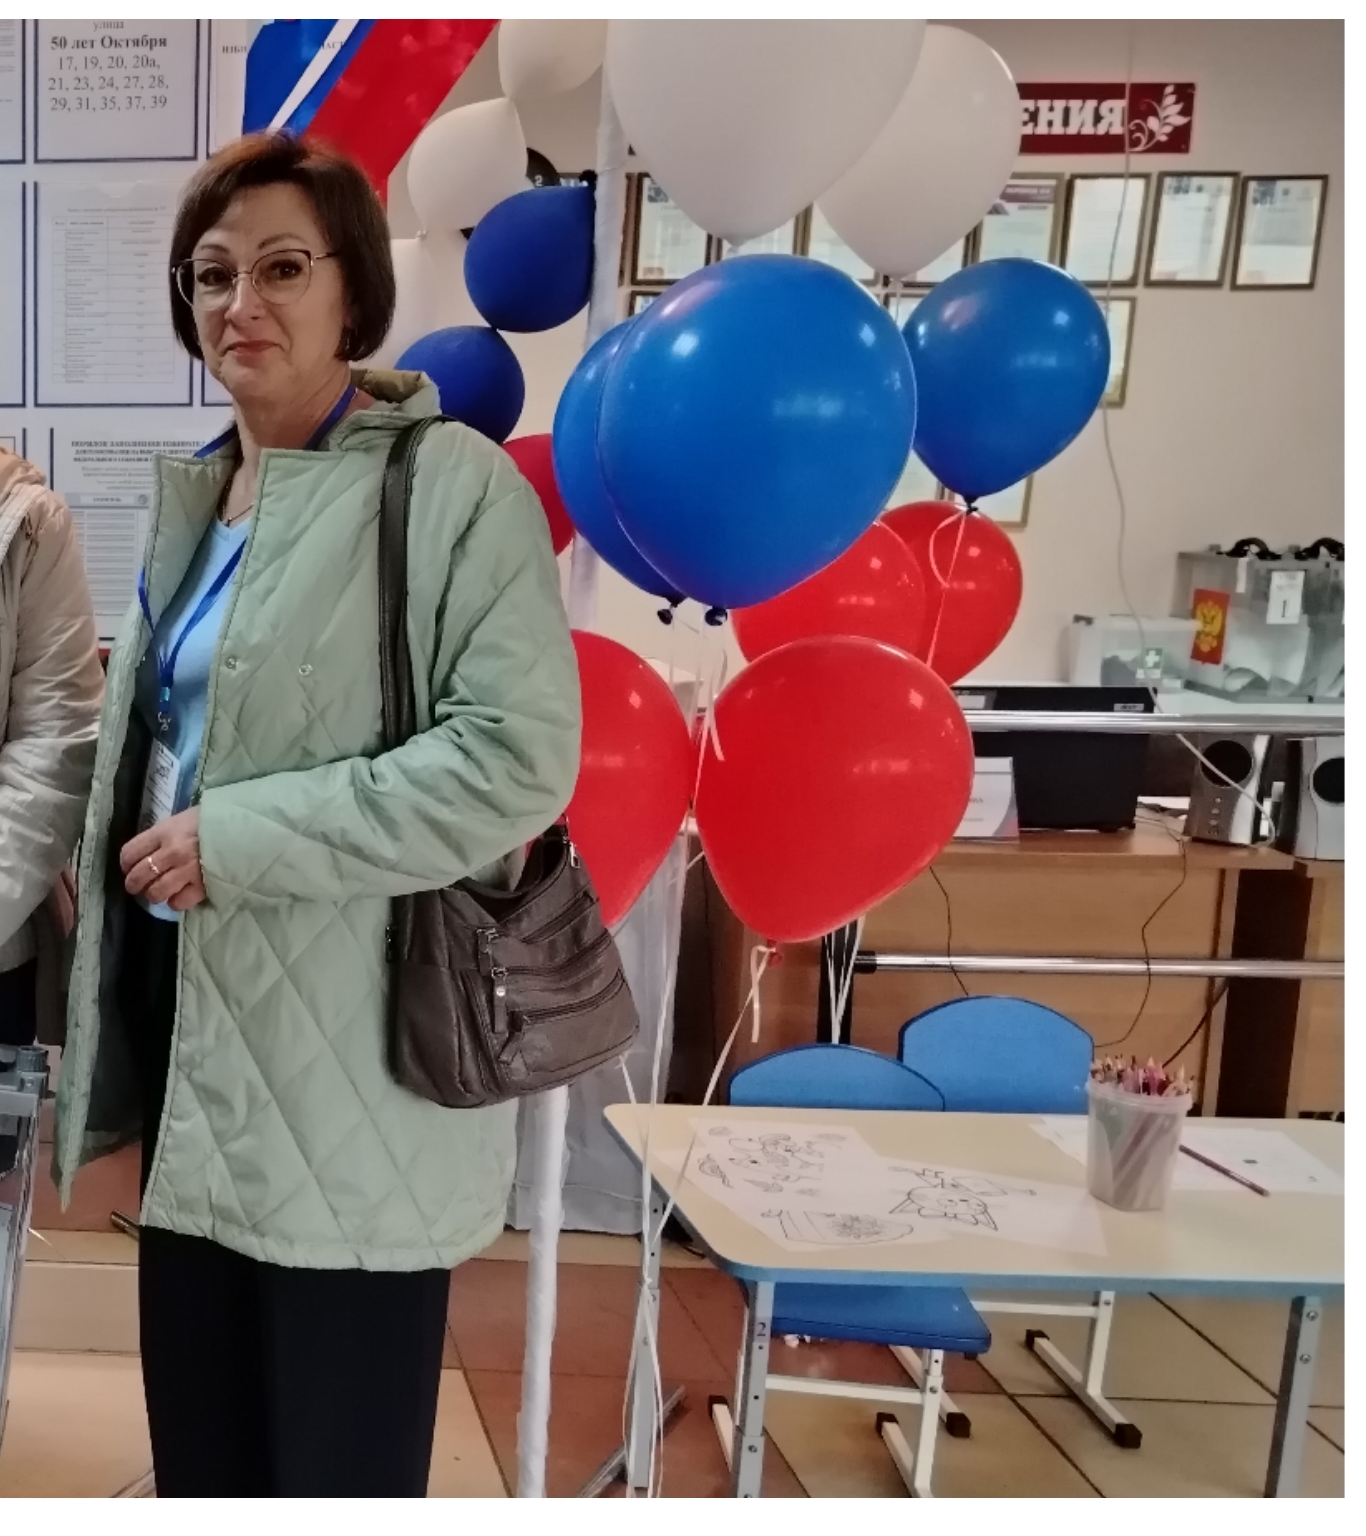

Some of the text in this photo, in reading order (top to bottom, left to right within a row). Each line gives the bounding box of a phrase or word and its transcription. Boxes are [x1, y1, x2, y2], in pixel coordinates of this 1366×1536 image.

[93, 21, 125, 31] улица
[50, 35, 167, 51] 50 лет Октября
[59, 54, 160, 71] 17, 19, 20, 20а,
[48, 75, 169, 92] 21, 23, 24, 27, 28,
[50, 95, 167, 112] 29, 31, 35, 37, 39
[756, 1321, 767, 1337] 2
